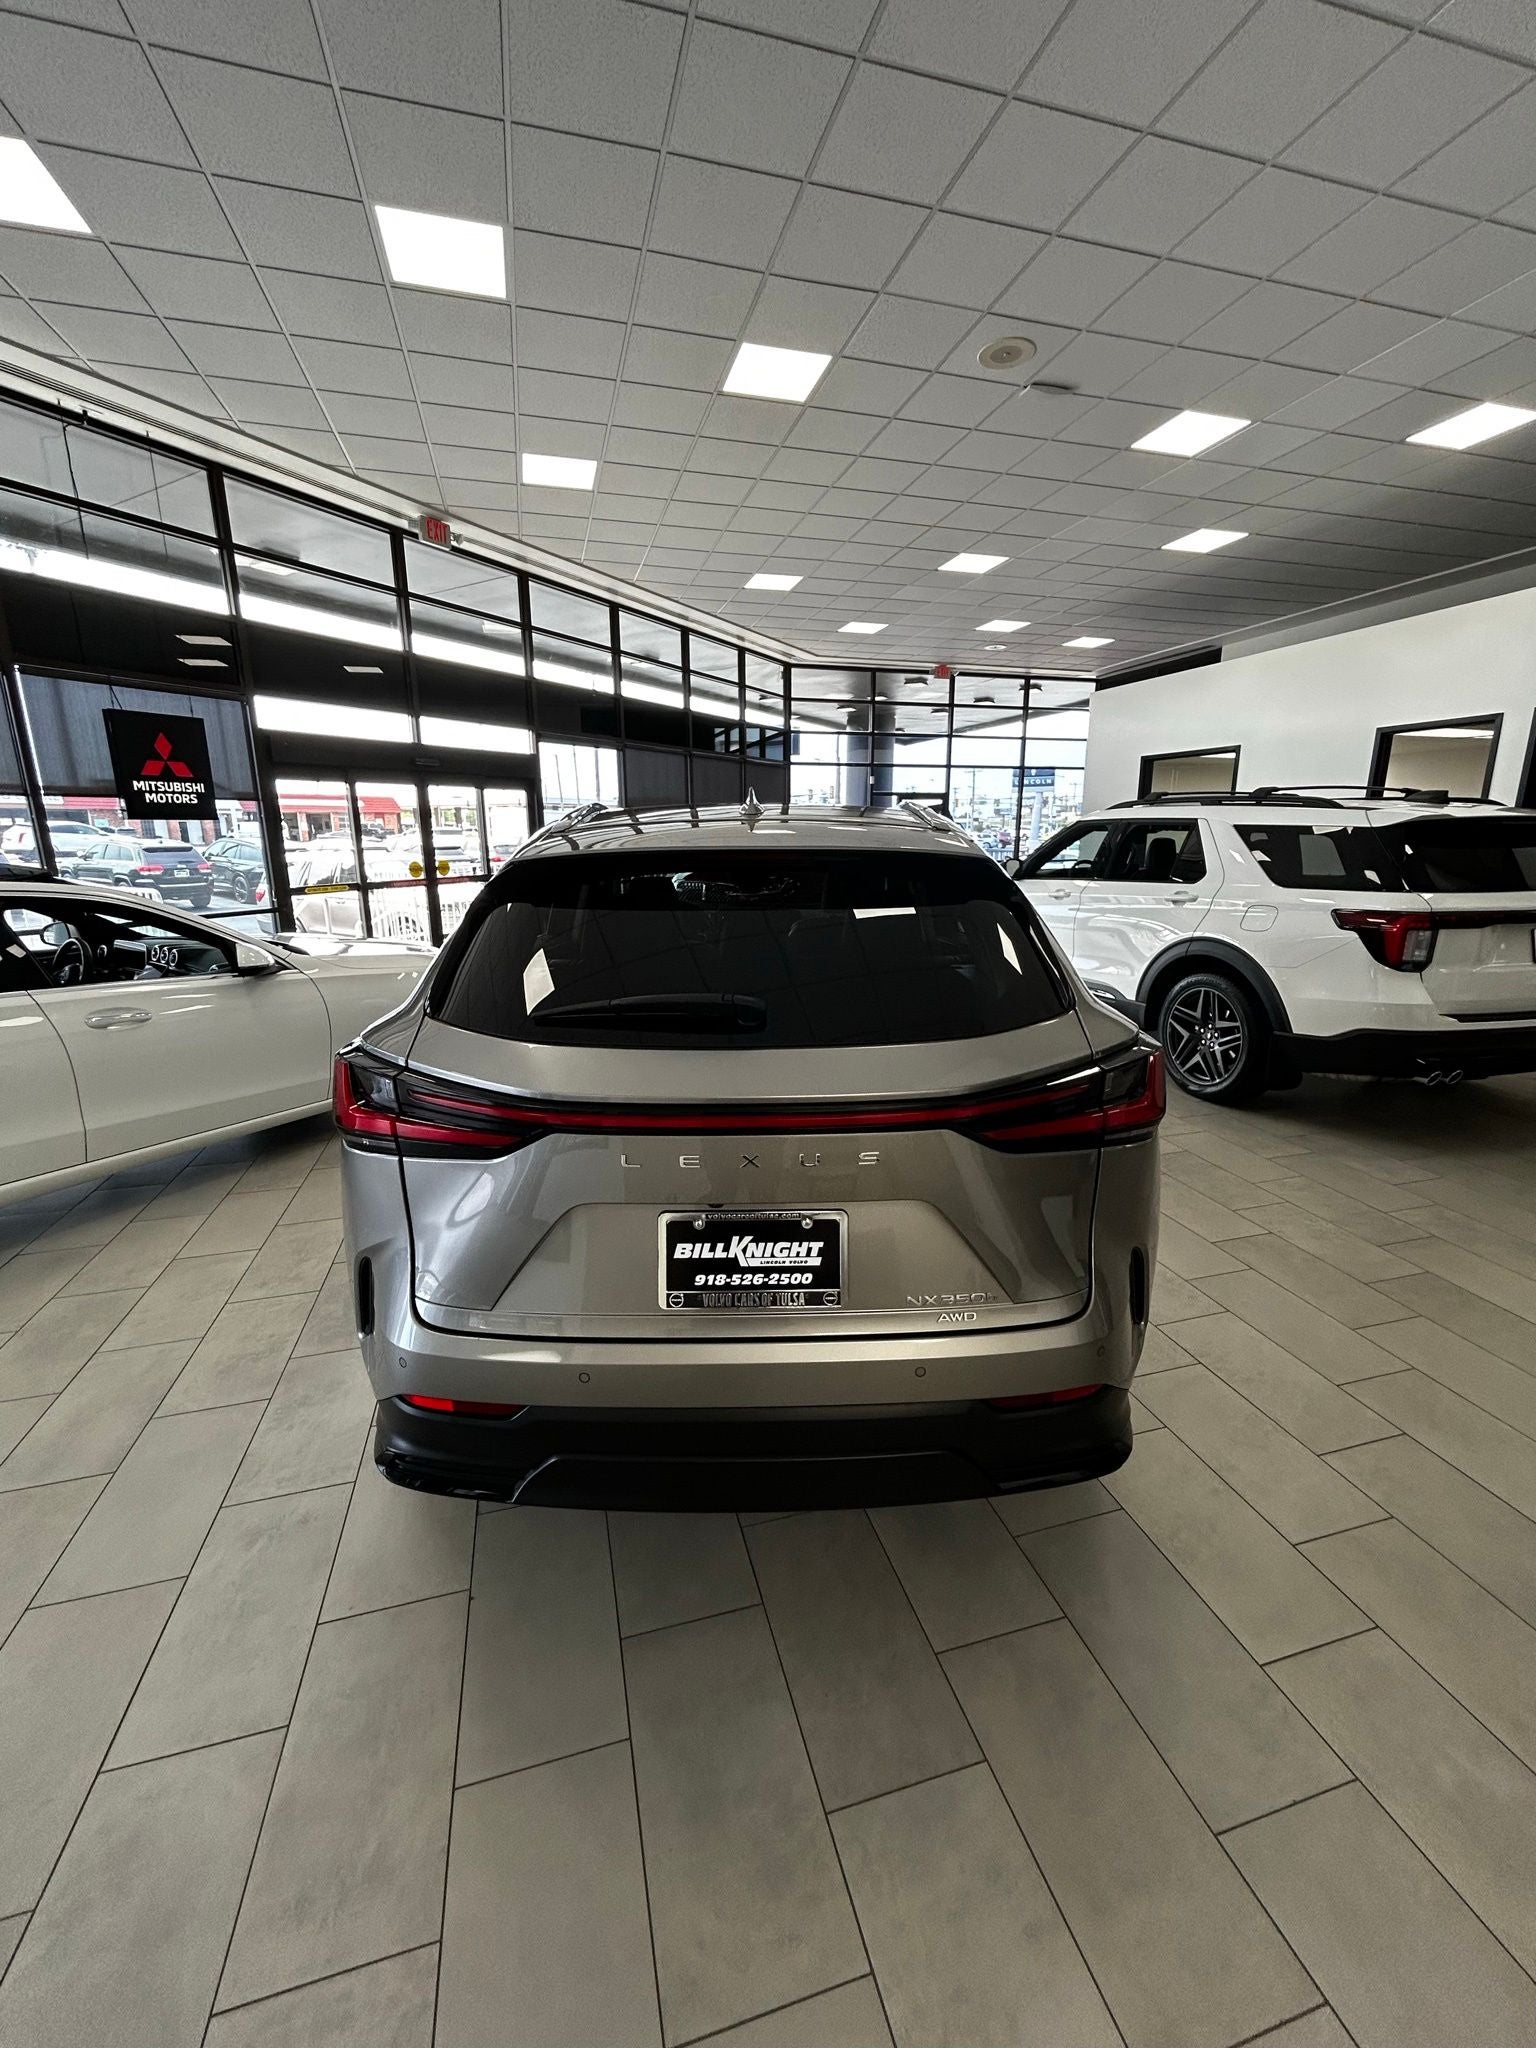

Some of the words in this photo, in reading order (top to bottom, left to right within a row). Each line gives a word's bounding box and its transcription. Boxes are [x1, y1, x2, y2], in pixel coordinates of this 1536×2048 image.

[427, 518, 448, 544] EXIT
[132, 780, 205, 793] MITSUBISHI
[145, 792, 199, 804] MOTORS
[620, 1151, 880, 1168] LEXUS
[694, 1273, 813, 1286] 918-526-2500
[702, 1293, 732, 1307] VOLVO
[734, 1293, 760, 1307] CARS
[762, 1293, 773, 1306] OF
[776, 1292, 806, 1306] TULSA
[937, 1312, 977, 1323] AWD
